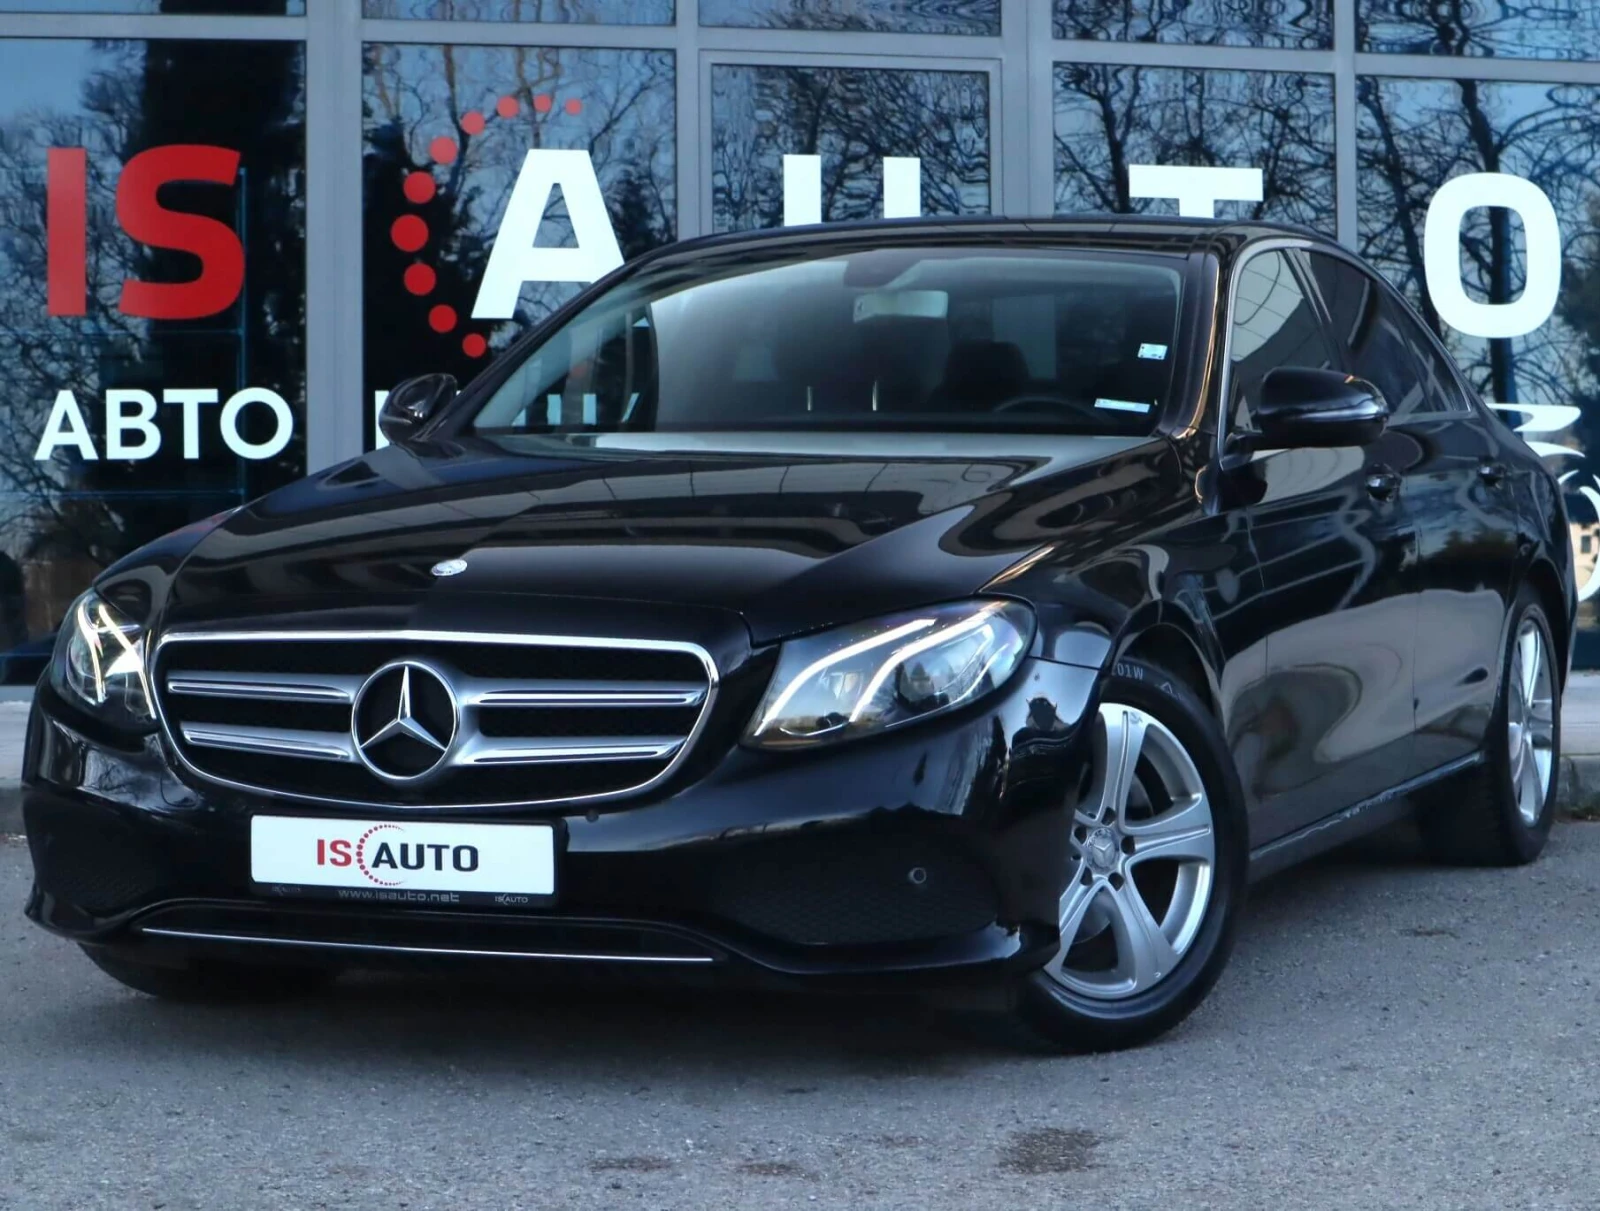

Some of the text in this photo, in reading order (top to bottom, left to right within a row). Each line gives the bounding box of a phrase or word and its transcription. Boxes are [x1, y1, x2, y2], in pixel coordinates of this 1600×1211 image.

[47, 144, 245, 319] IS
[34, 386, 293, 461] АВТО
[316, 838, 479, 872] IS AUTO
[338, 889, 460, 902] www.isauto.net
